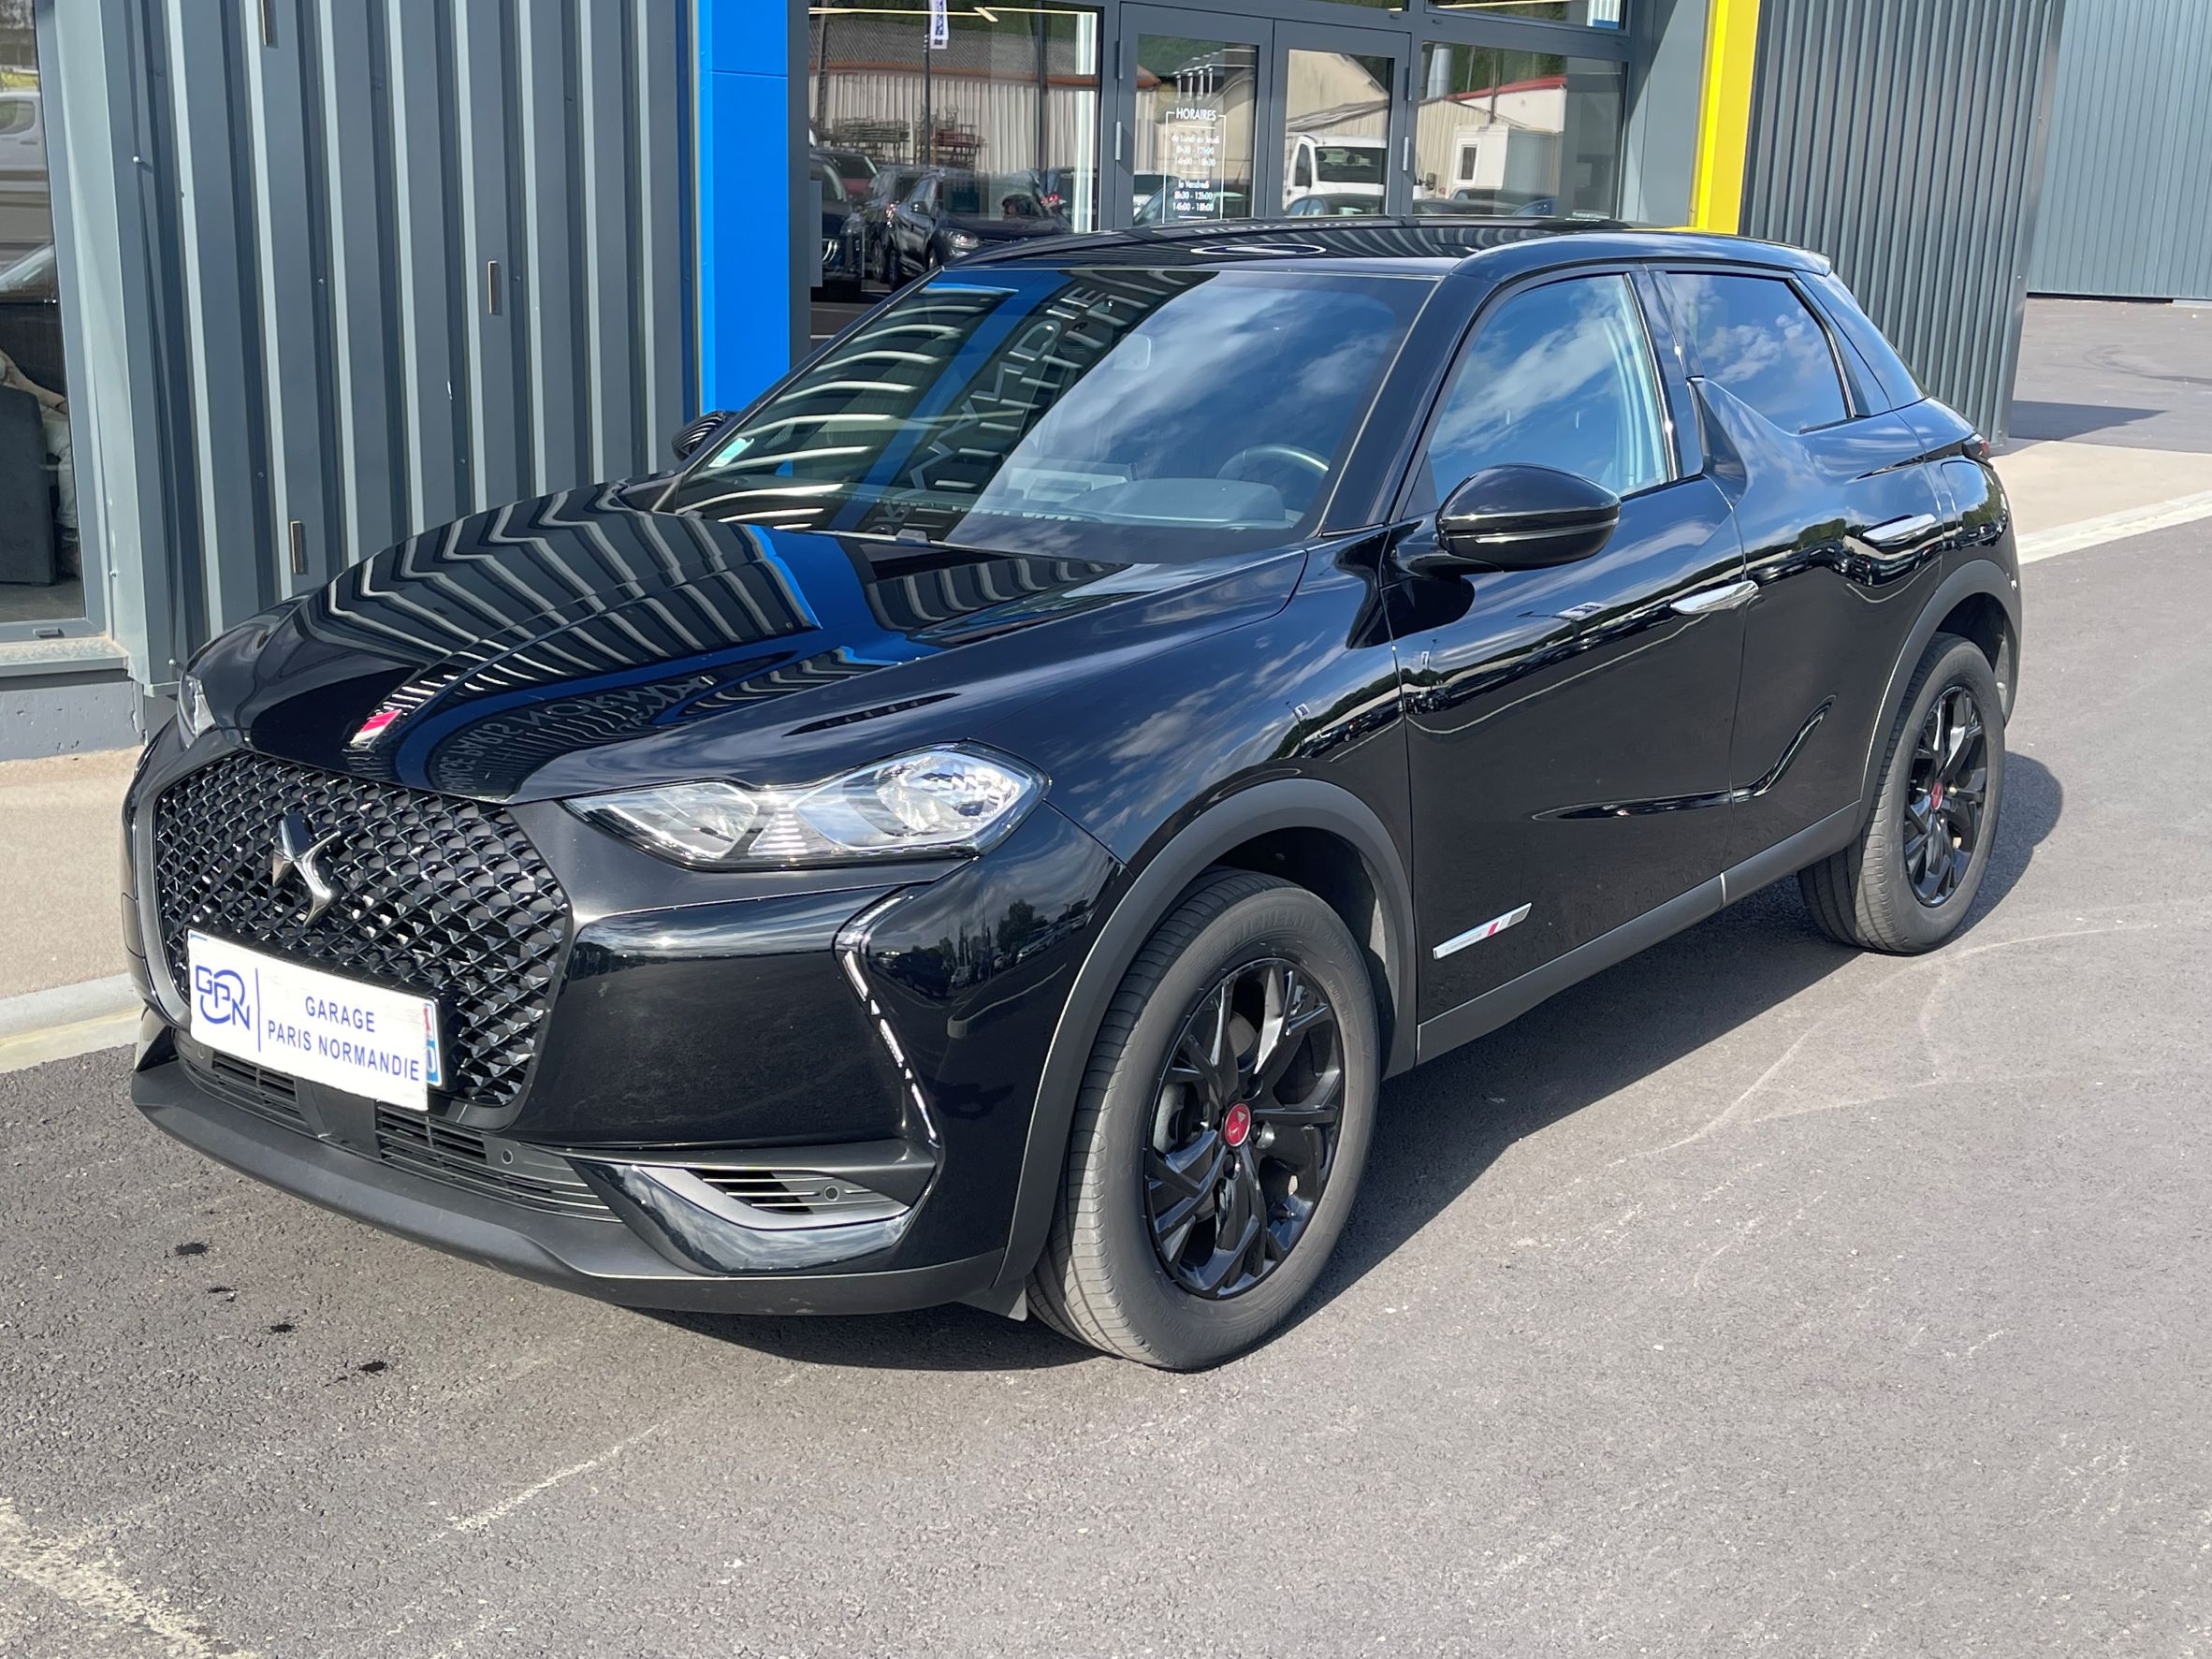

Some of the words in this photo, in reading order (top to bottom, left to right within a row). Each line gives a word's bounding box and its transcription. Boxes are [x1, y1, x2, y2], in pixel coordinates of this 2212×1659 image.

[1176, 108, 1216, 121] HORAIRES
[1186, 180, 1210, 189] Vendredi
[1174, 190, 1189, 199] 8h30
[1195, 191, 1213, 200] 12h00
[1172, 202, 1191, 211] 14h00
[304, 995, 376, 1033] GARAGE
[267, 1019, 313, 1052] PARIS
[317, 1035, 420, 1083] NORMANDIE
